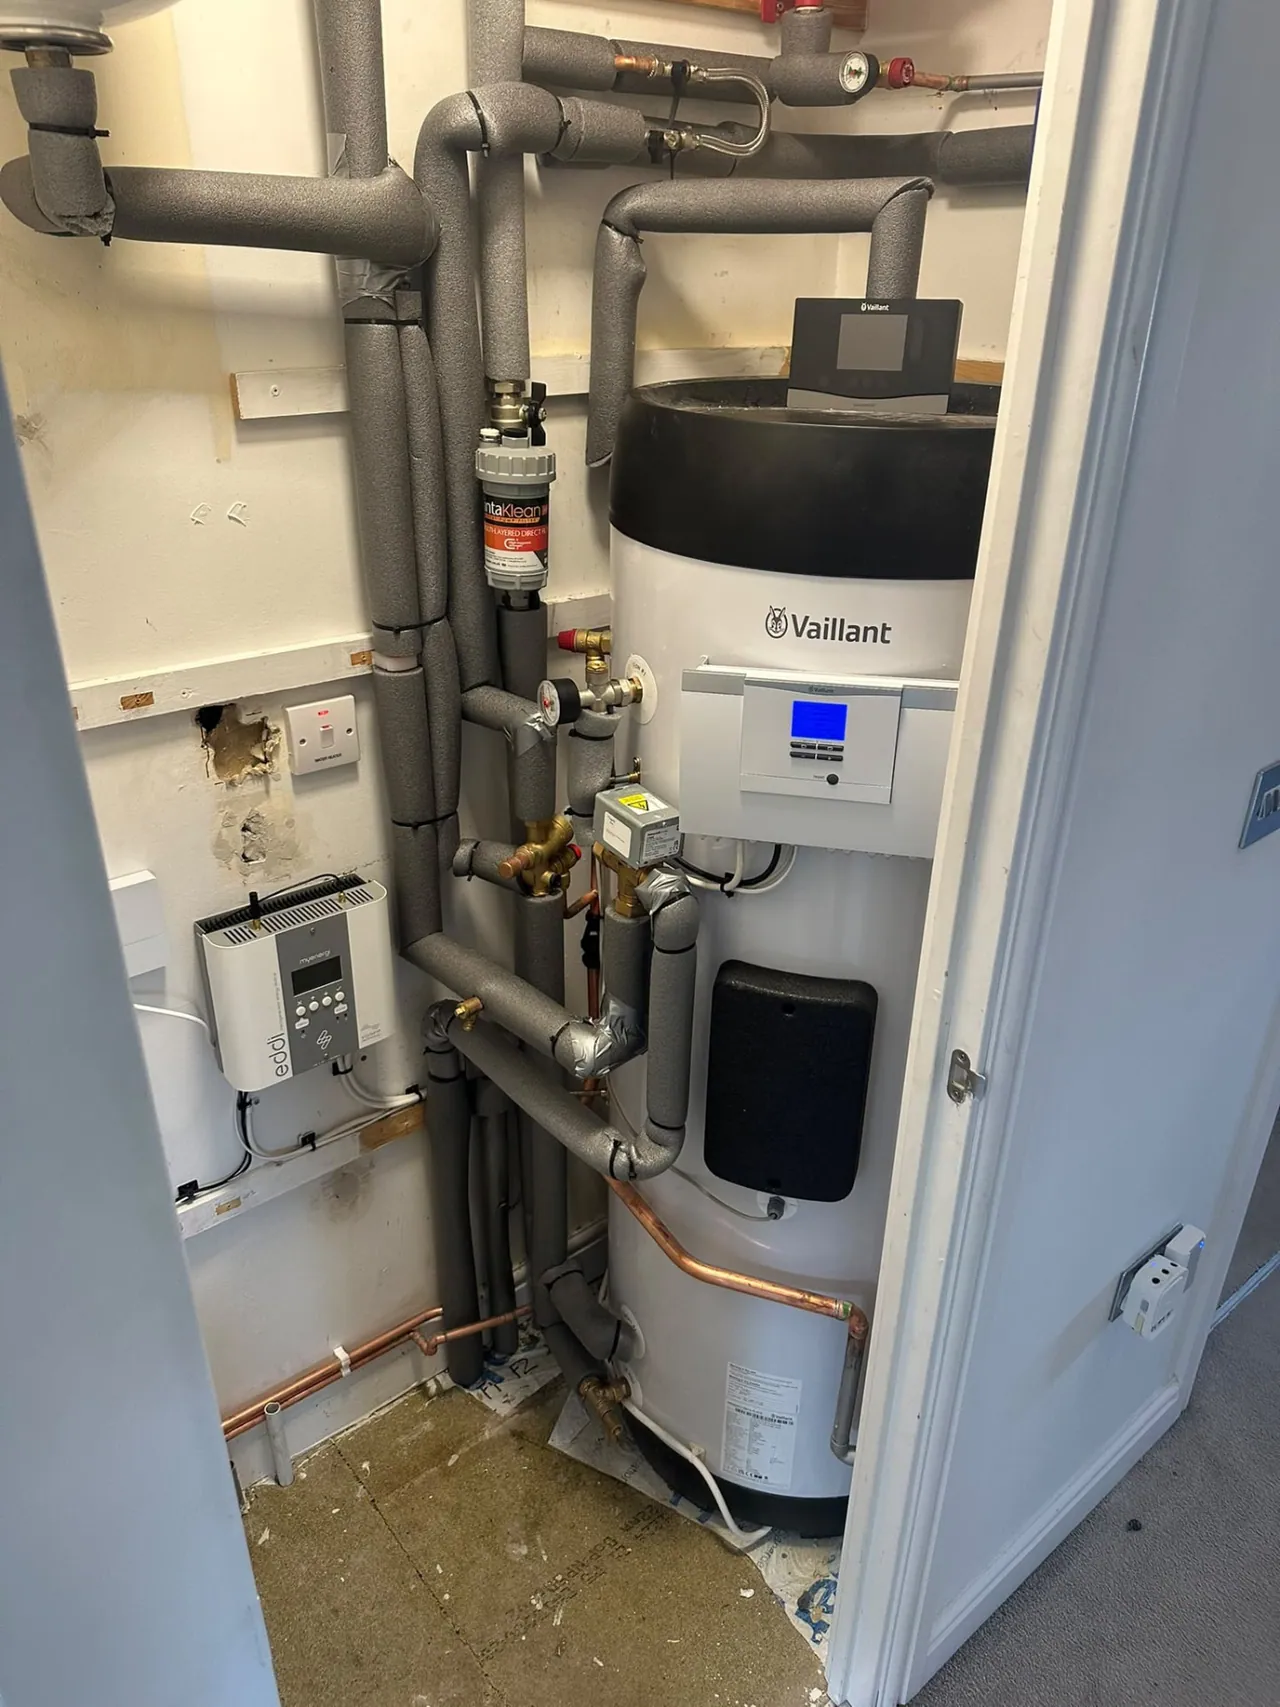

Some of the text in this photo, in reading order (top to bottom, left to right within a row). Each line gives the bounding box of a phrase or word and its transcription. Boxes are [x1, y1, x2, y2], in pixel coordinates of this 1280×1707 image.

[866, 303, 889, 311] Vaillant
[484, 501, 541, 518] ntaKlean
[791, 614, 892, 644] Vaillant
[267, 1032, 289, 1077] eddi
